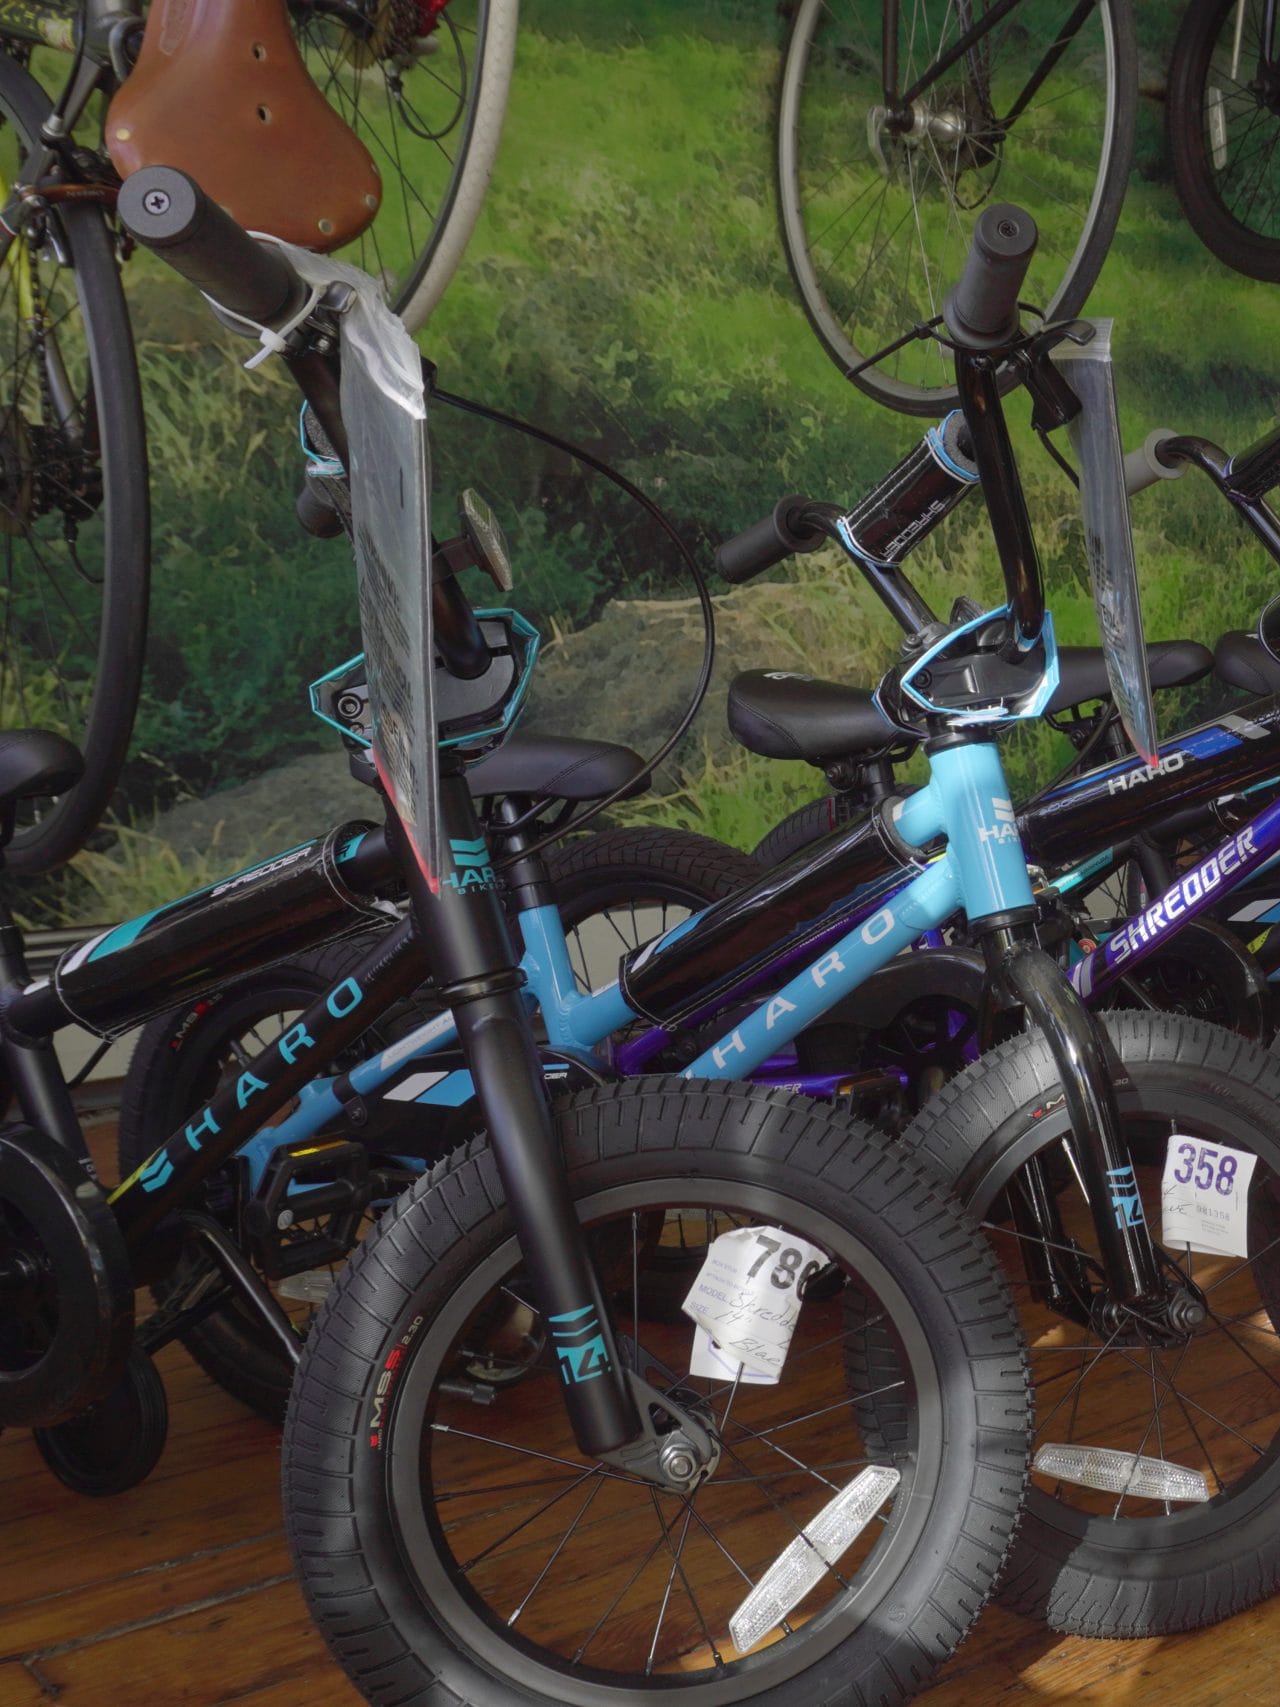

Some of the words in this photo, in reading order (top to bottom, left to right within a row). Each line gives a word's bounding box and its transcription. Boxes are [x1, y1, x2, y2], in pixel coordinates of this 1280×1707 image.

[1110, 826, 1258, 965] SHREDDER
[712, 908, 896, 1070] HARO
[184, 976, 364, 1152] HARO
[1173, 1142, 1238, 1197] 358
[400, 1314, 425, 1346] 2.30
[697, 1283, 728, 1306] MODEL
